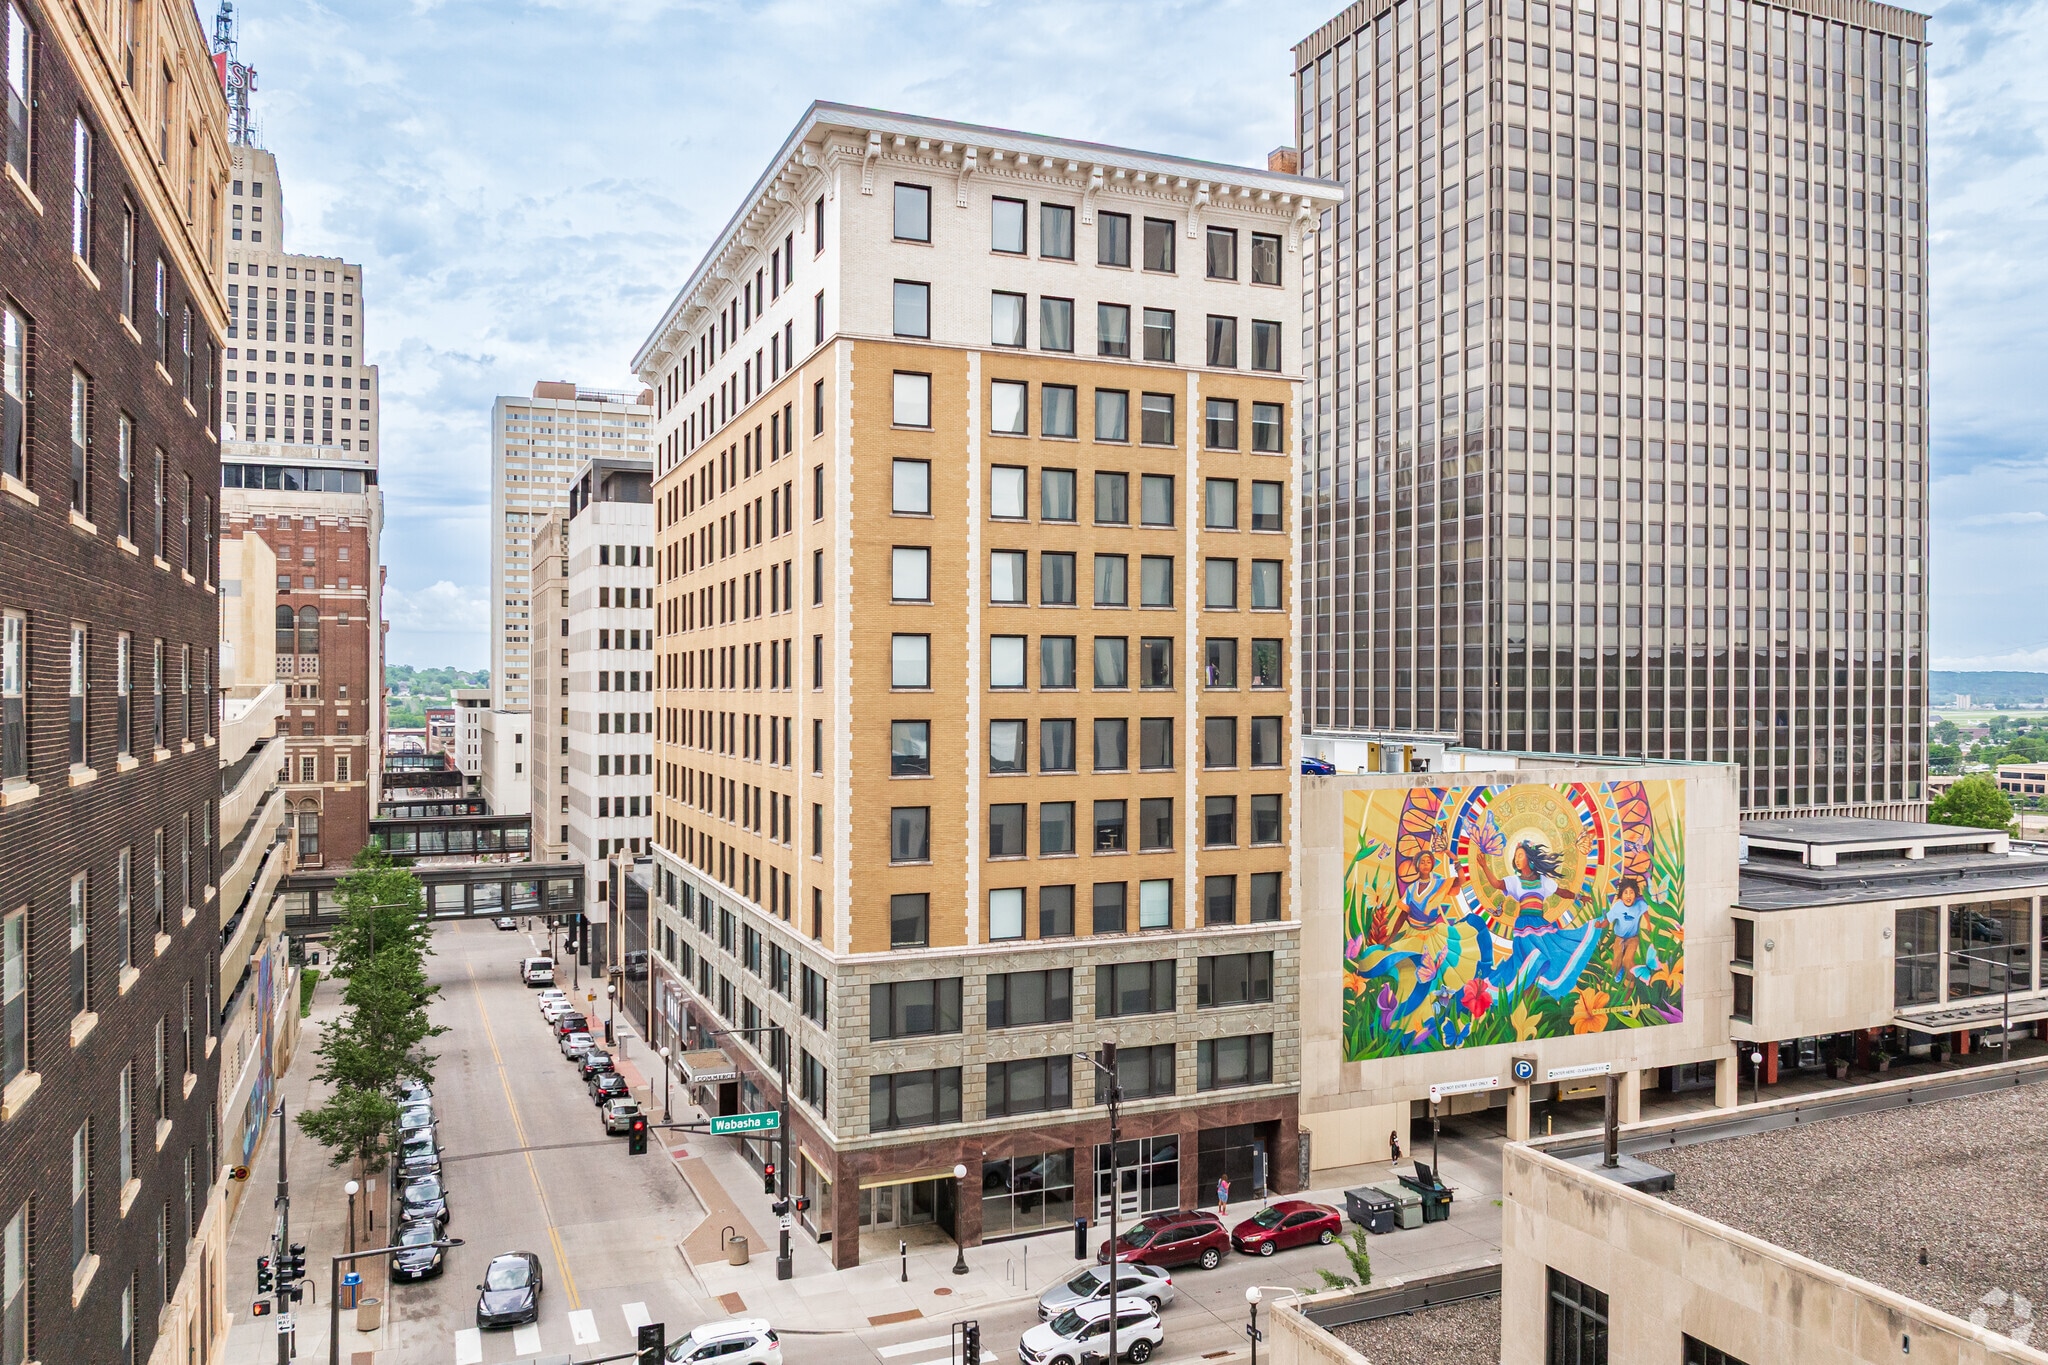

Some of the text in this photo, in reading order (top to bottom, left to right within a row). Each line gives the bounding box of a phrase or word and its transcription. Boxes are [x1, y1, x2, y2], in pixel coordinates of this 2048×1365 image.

[1520, 1064, 1529, 1076] P
[697, 1073, 734, 1081] COMMERCE
[716, 1117, 774, 1131] Wabasha St
